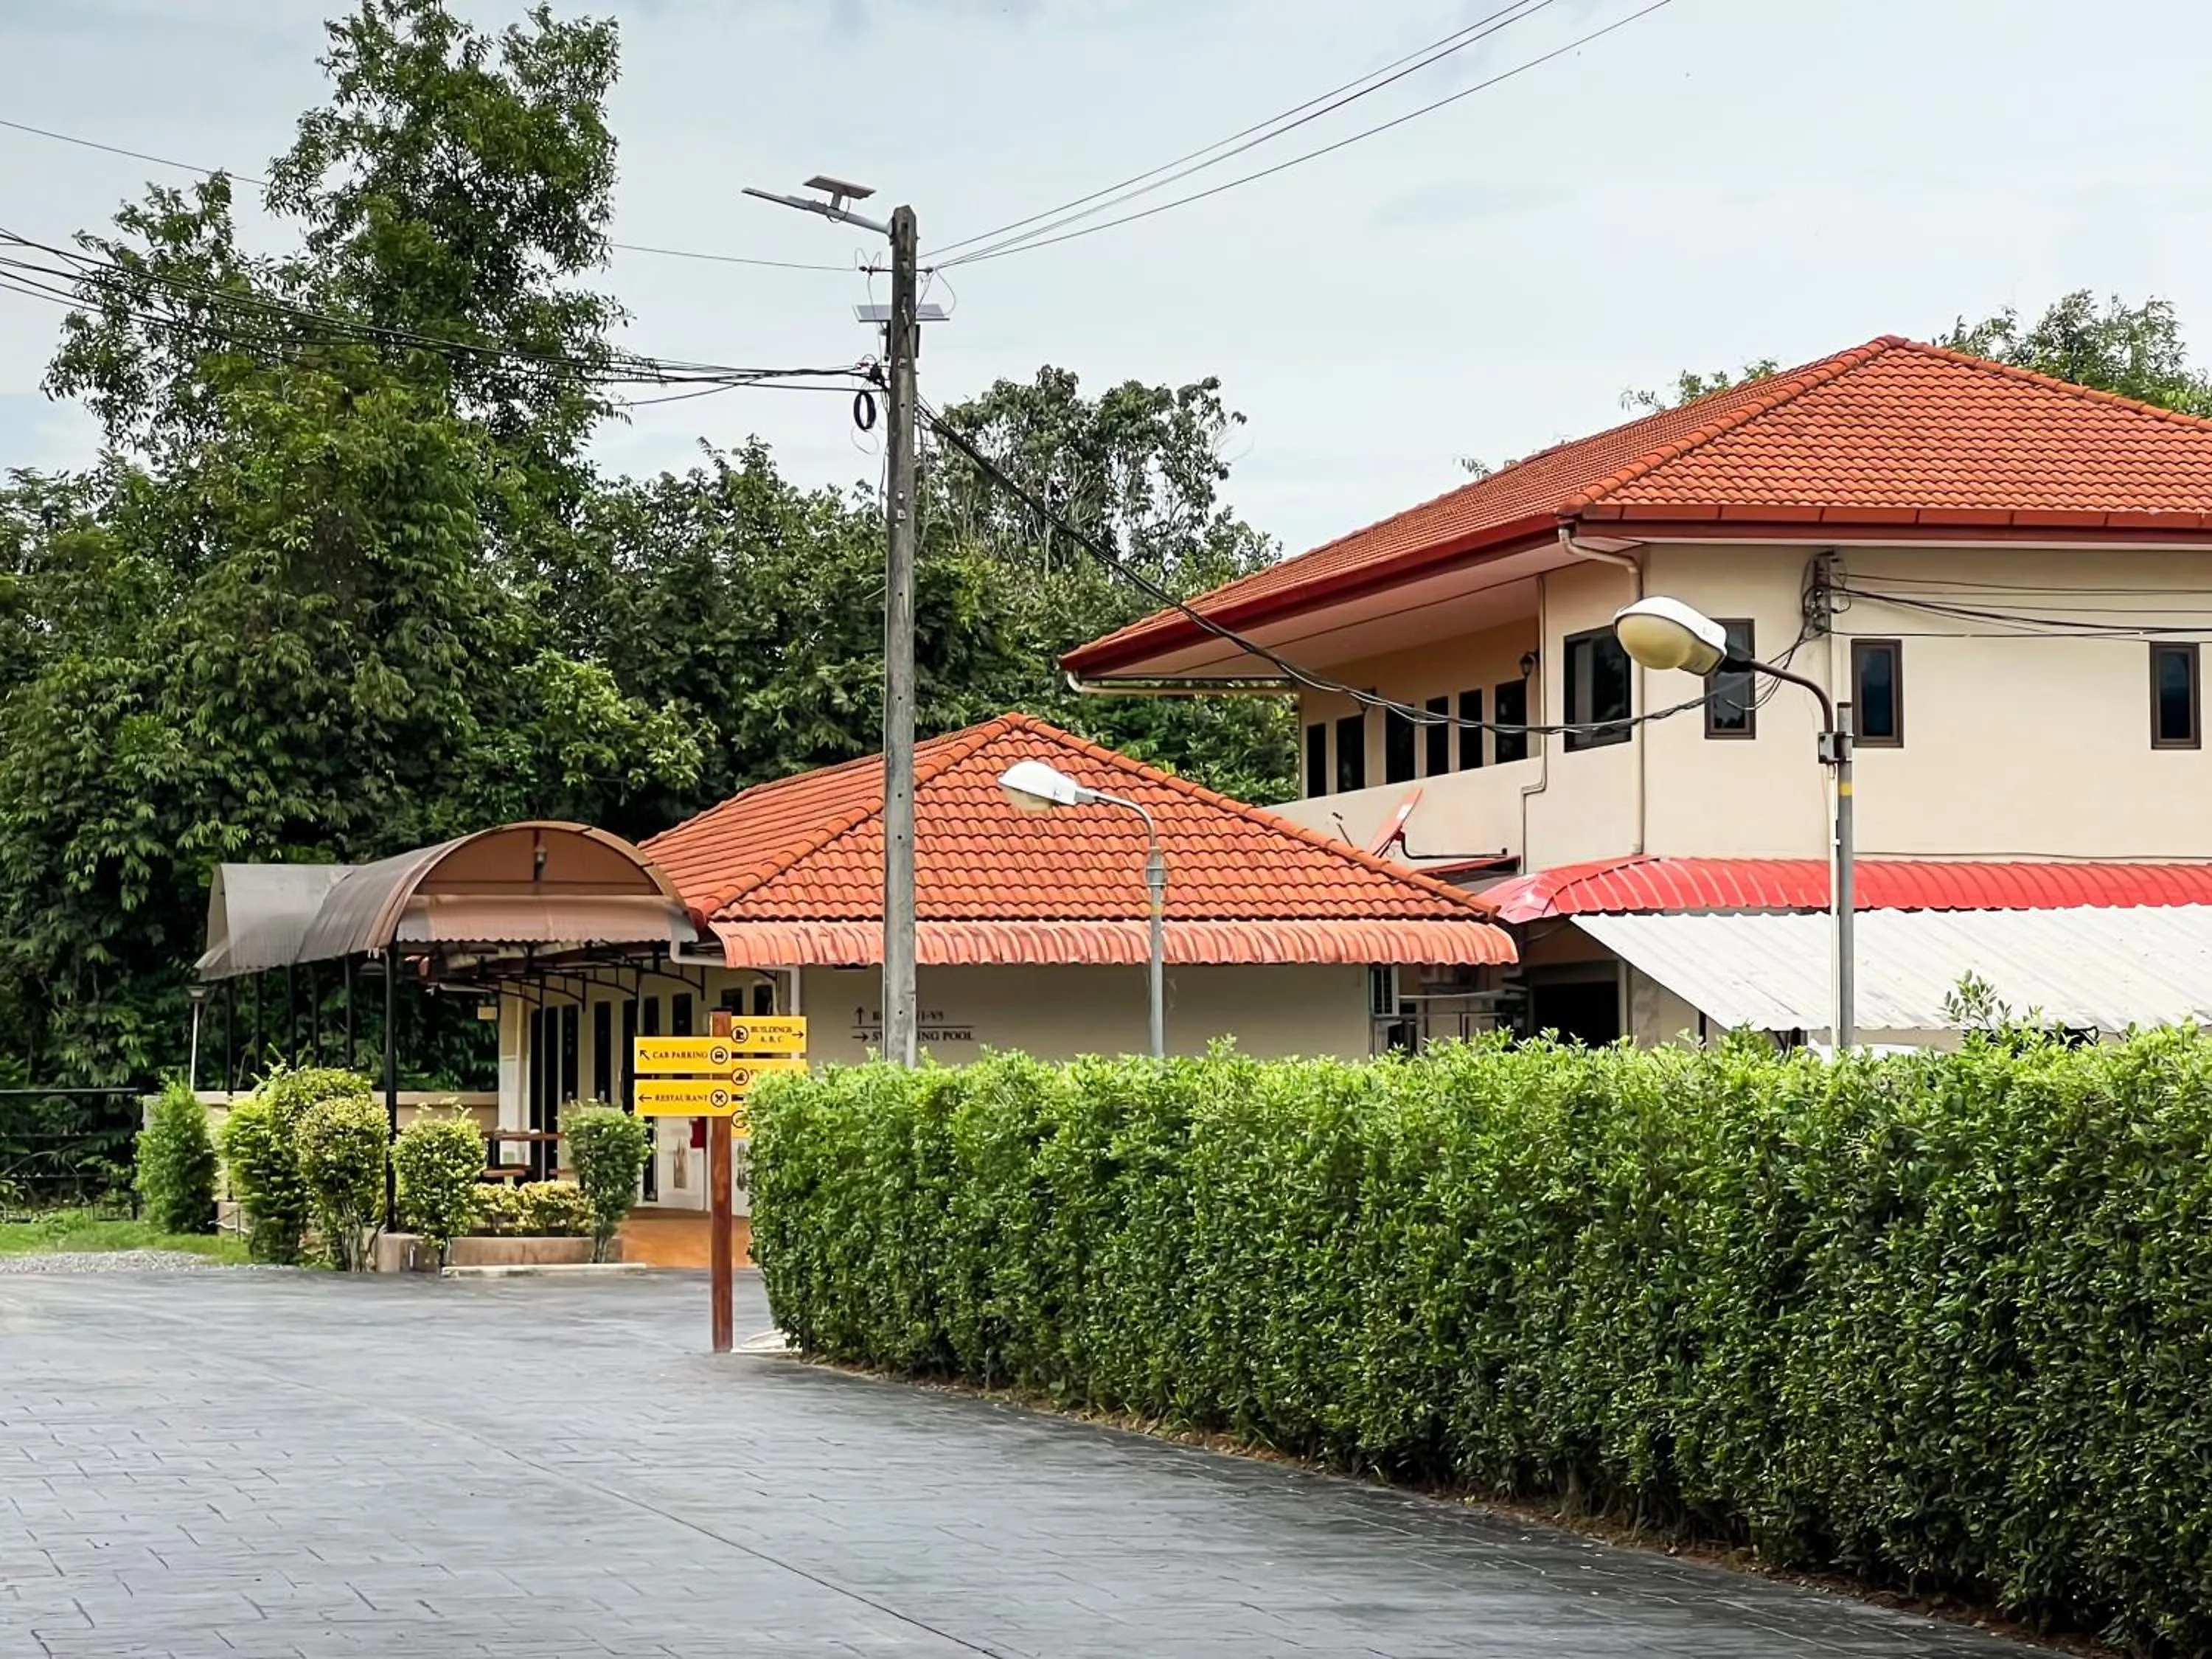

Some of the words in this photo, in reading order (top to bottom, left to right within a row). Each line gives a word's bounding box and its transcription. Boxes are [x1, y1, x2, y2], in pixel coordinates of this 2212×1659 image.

[943, 1030, 975, 1041] POOL
[653, 1051, 669, 1059] CAR
[672, 1051, 709, 1059] PARKING
